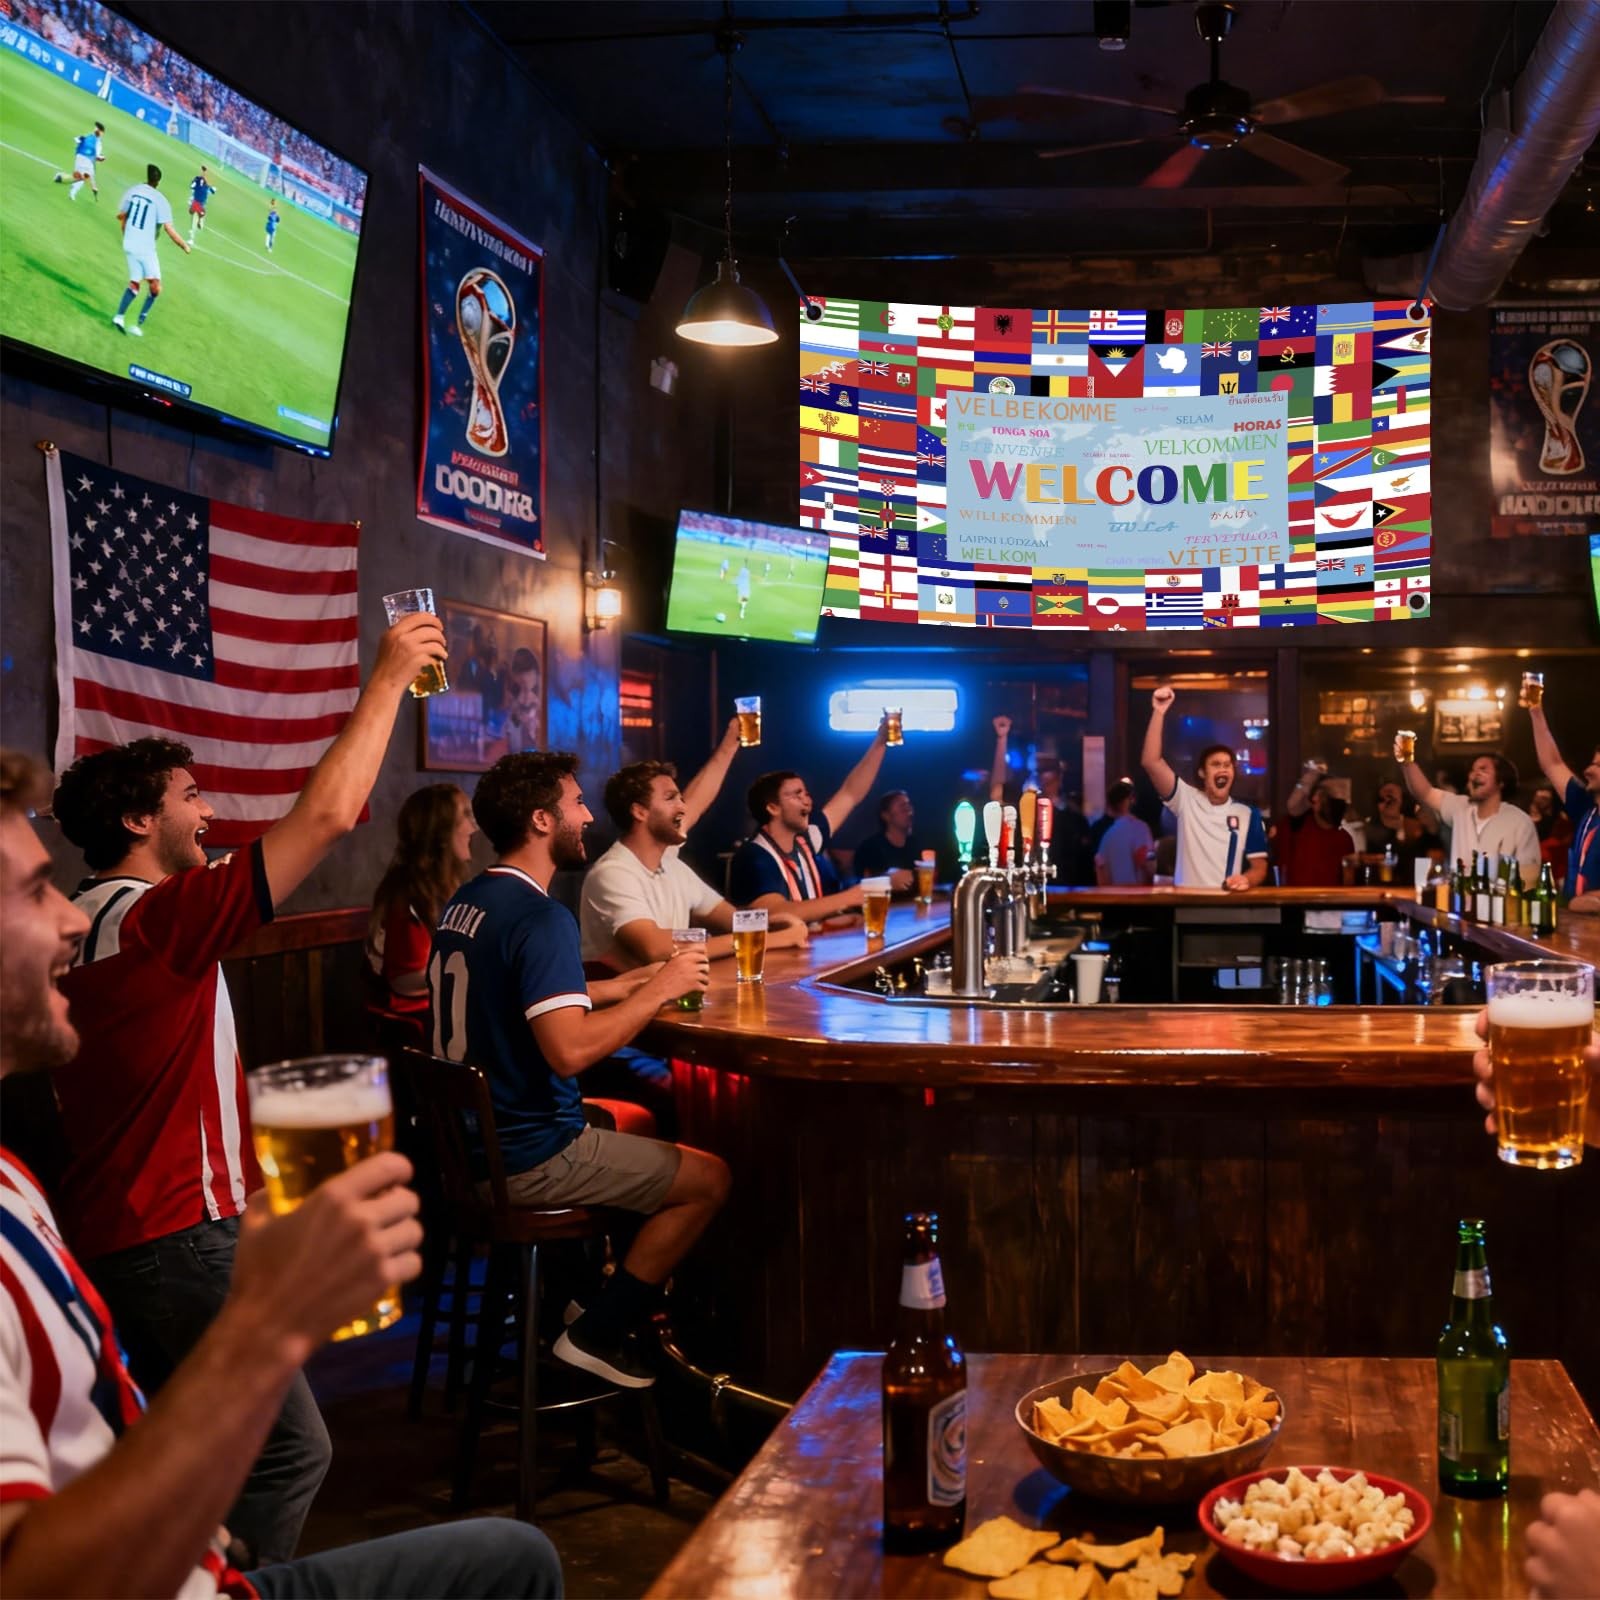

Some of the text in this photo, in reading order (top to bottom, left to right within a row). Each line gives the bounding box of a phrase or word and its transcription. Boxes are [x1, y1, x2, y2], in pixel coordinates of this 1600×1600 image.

[955, 396, 1118, 422] VELBEKOMME
[1176, 414, 1214, 424] SELAM
[1233, 419, 1282, 432] HORAS
[991, 426, 1051, 438] TONGA SOA
[1144, 433, 1278, 456] VELKOMMEN
[968, 459, 1269, 506] WELCOME
[959, 509, 1077, 526] WILLKOMMEN
[1211, 508, 1257, 520] かんげい
[1107, 521, 1179, 533] BULA
[961, 547, 1037, 563] WELKOM
[1168, 545, 1281, 566] VÍTEJTE
